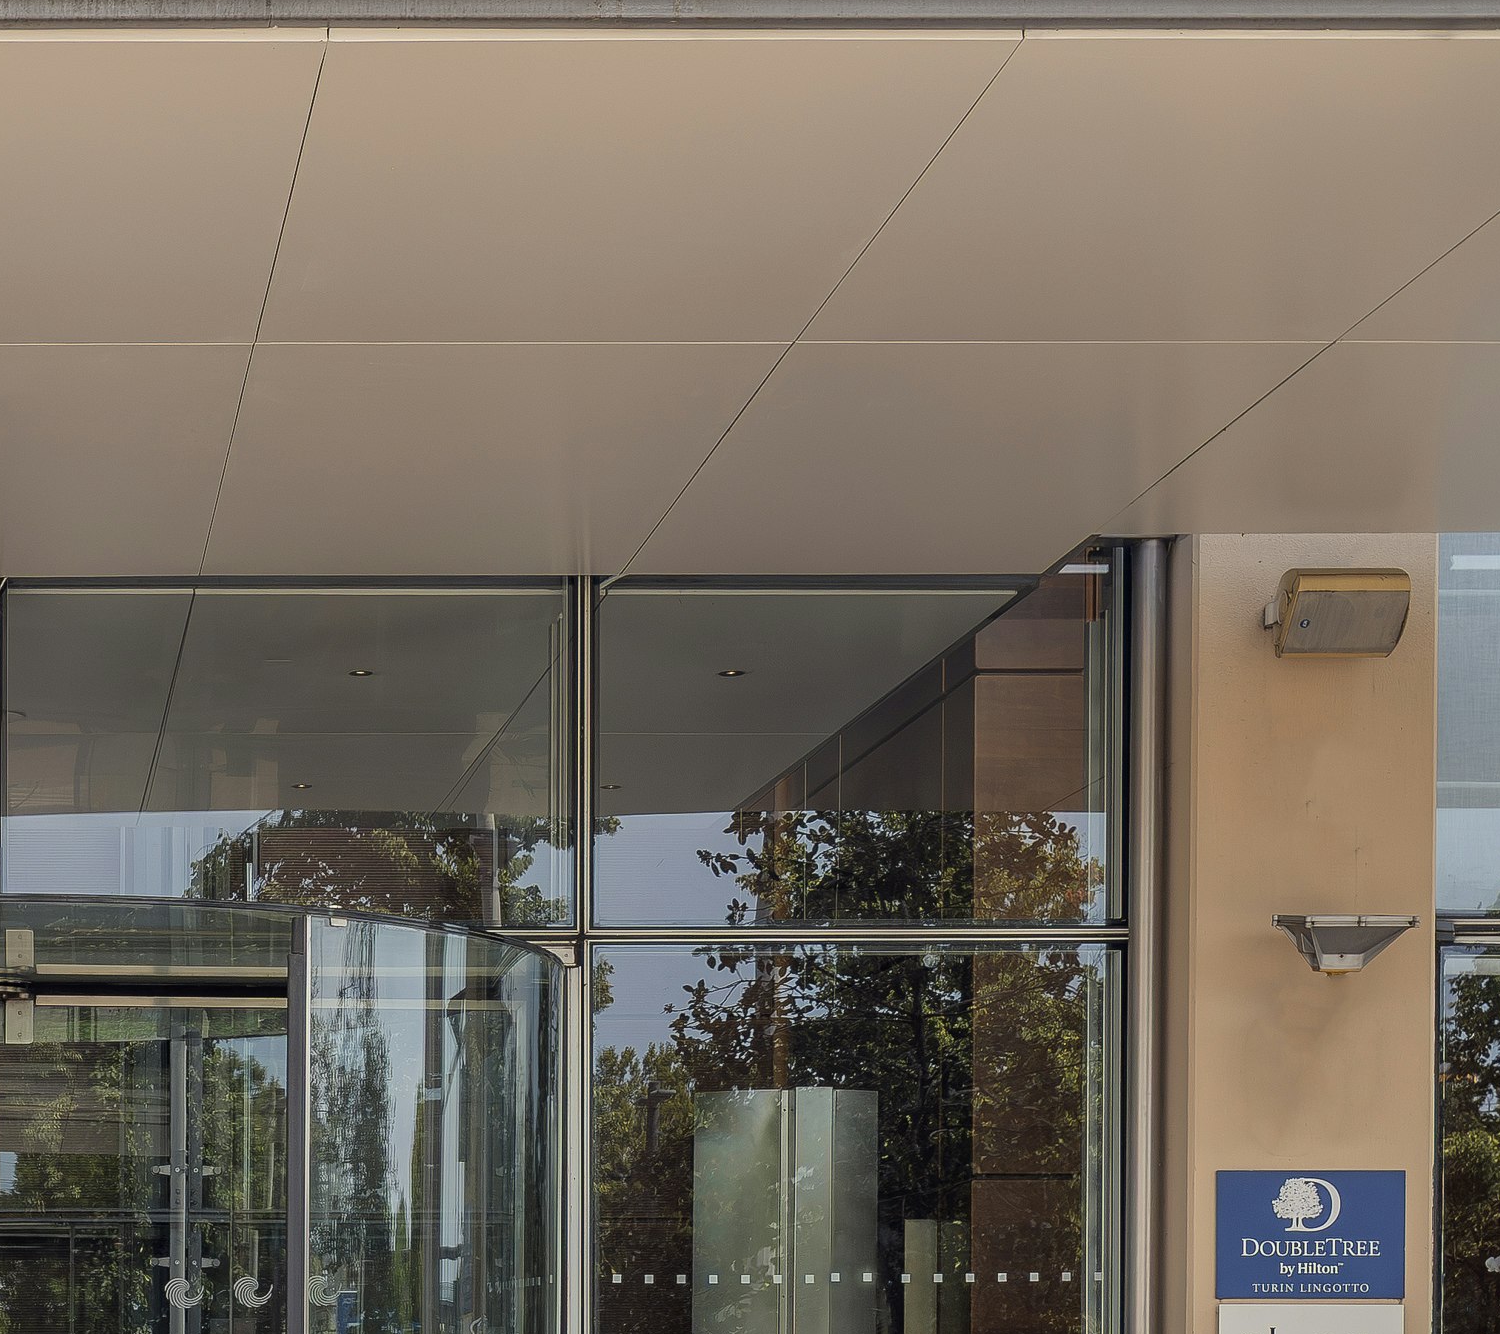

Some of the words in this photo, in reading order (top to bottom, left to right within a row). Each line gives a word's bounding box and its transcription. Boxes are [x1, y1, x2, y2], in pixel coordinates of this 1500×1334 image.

[1279, 1262, 1296, 1277] by
[1251, 1283, 1294, 1293] TURIN
[1300, 1283, 1370, 1293] LINGOTTO
